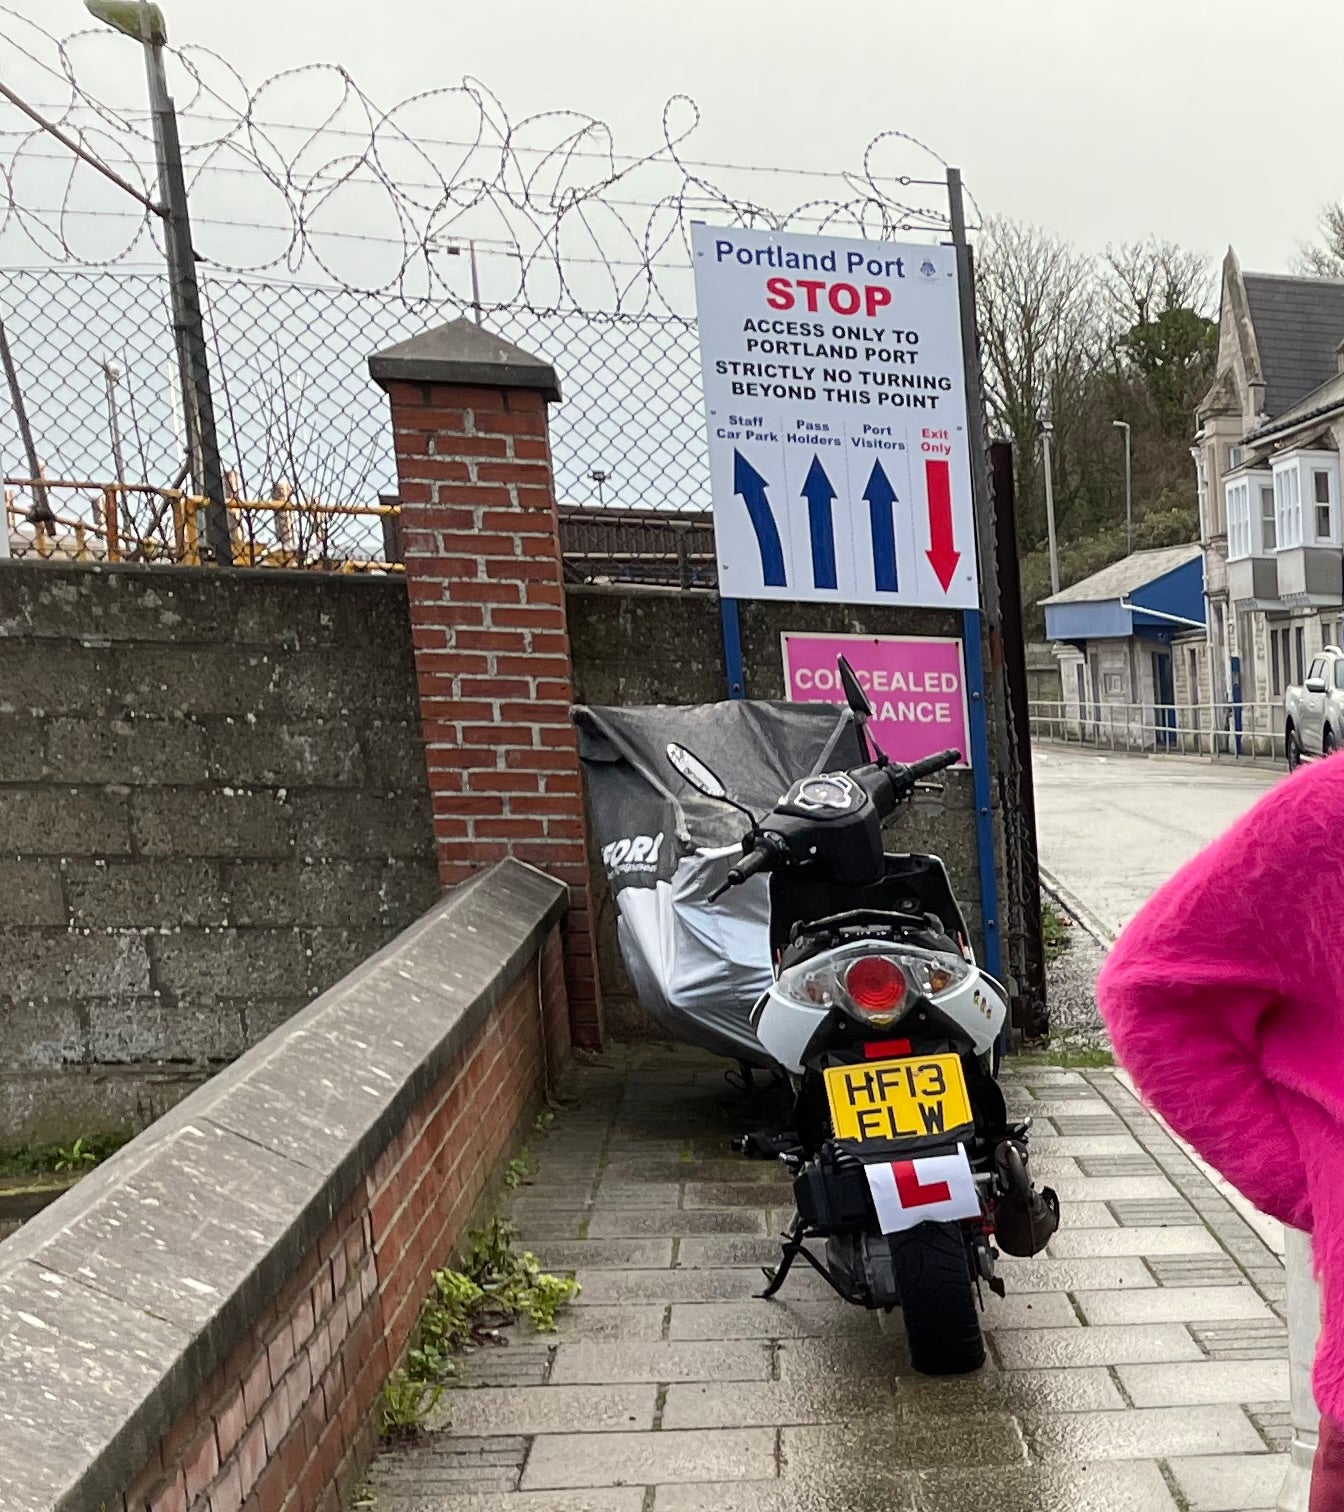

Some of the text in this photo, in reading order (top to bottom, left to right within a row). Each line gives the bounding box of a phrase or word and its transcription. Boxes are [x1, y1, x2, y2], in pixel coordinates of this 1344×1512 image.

[716, 240, 905, 278] Portland Port
[766, 277, 892, 318] STOP
[743, 318, 919, 345] ACCESS ONLY TO
[747, 339, 918, 365] PORTLAND PORT
[716, 361, 952, 392] STRICTLY NO TURNING
[732, 382, 940, 409] BEYOND THIS POINT
[729, 415, 764, 427] Staff
[796, 419, 829, 432] Pass
[863, 423, 892, 436] Port
[716, 429, 779, 442] Car Park
[787, 433, 841, 446] Holders
[851, 437, 905, 450] Visitors
[922, 428, 948, 440] Exit
[920, 442, 951, 456] Only
[845, 1063, 946, 1106] HF13
[891, 1160, 952, 1209] L
